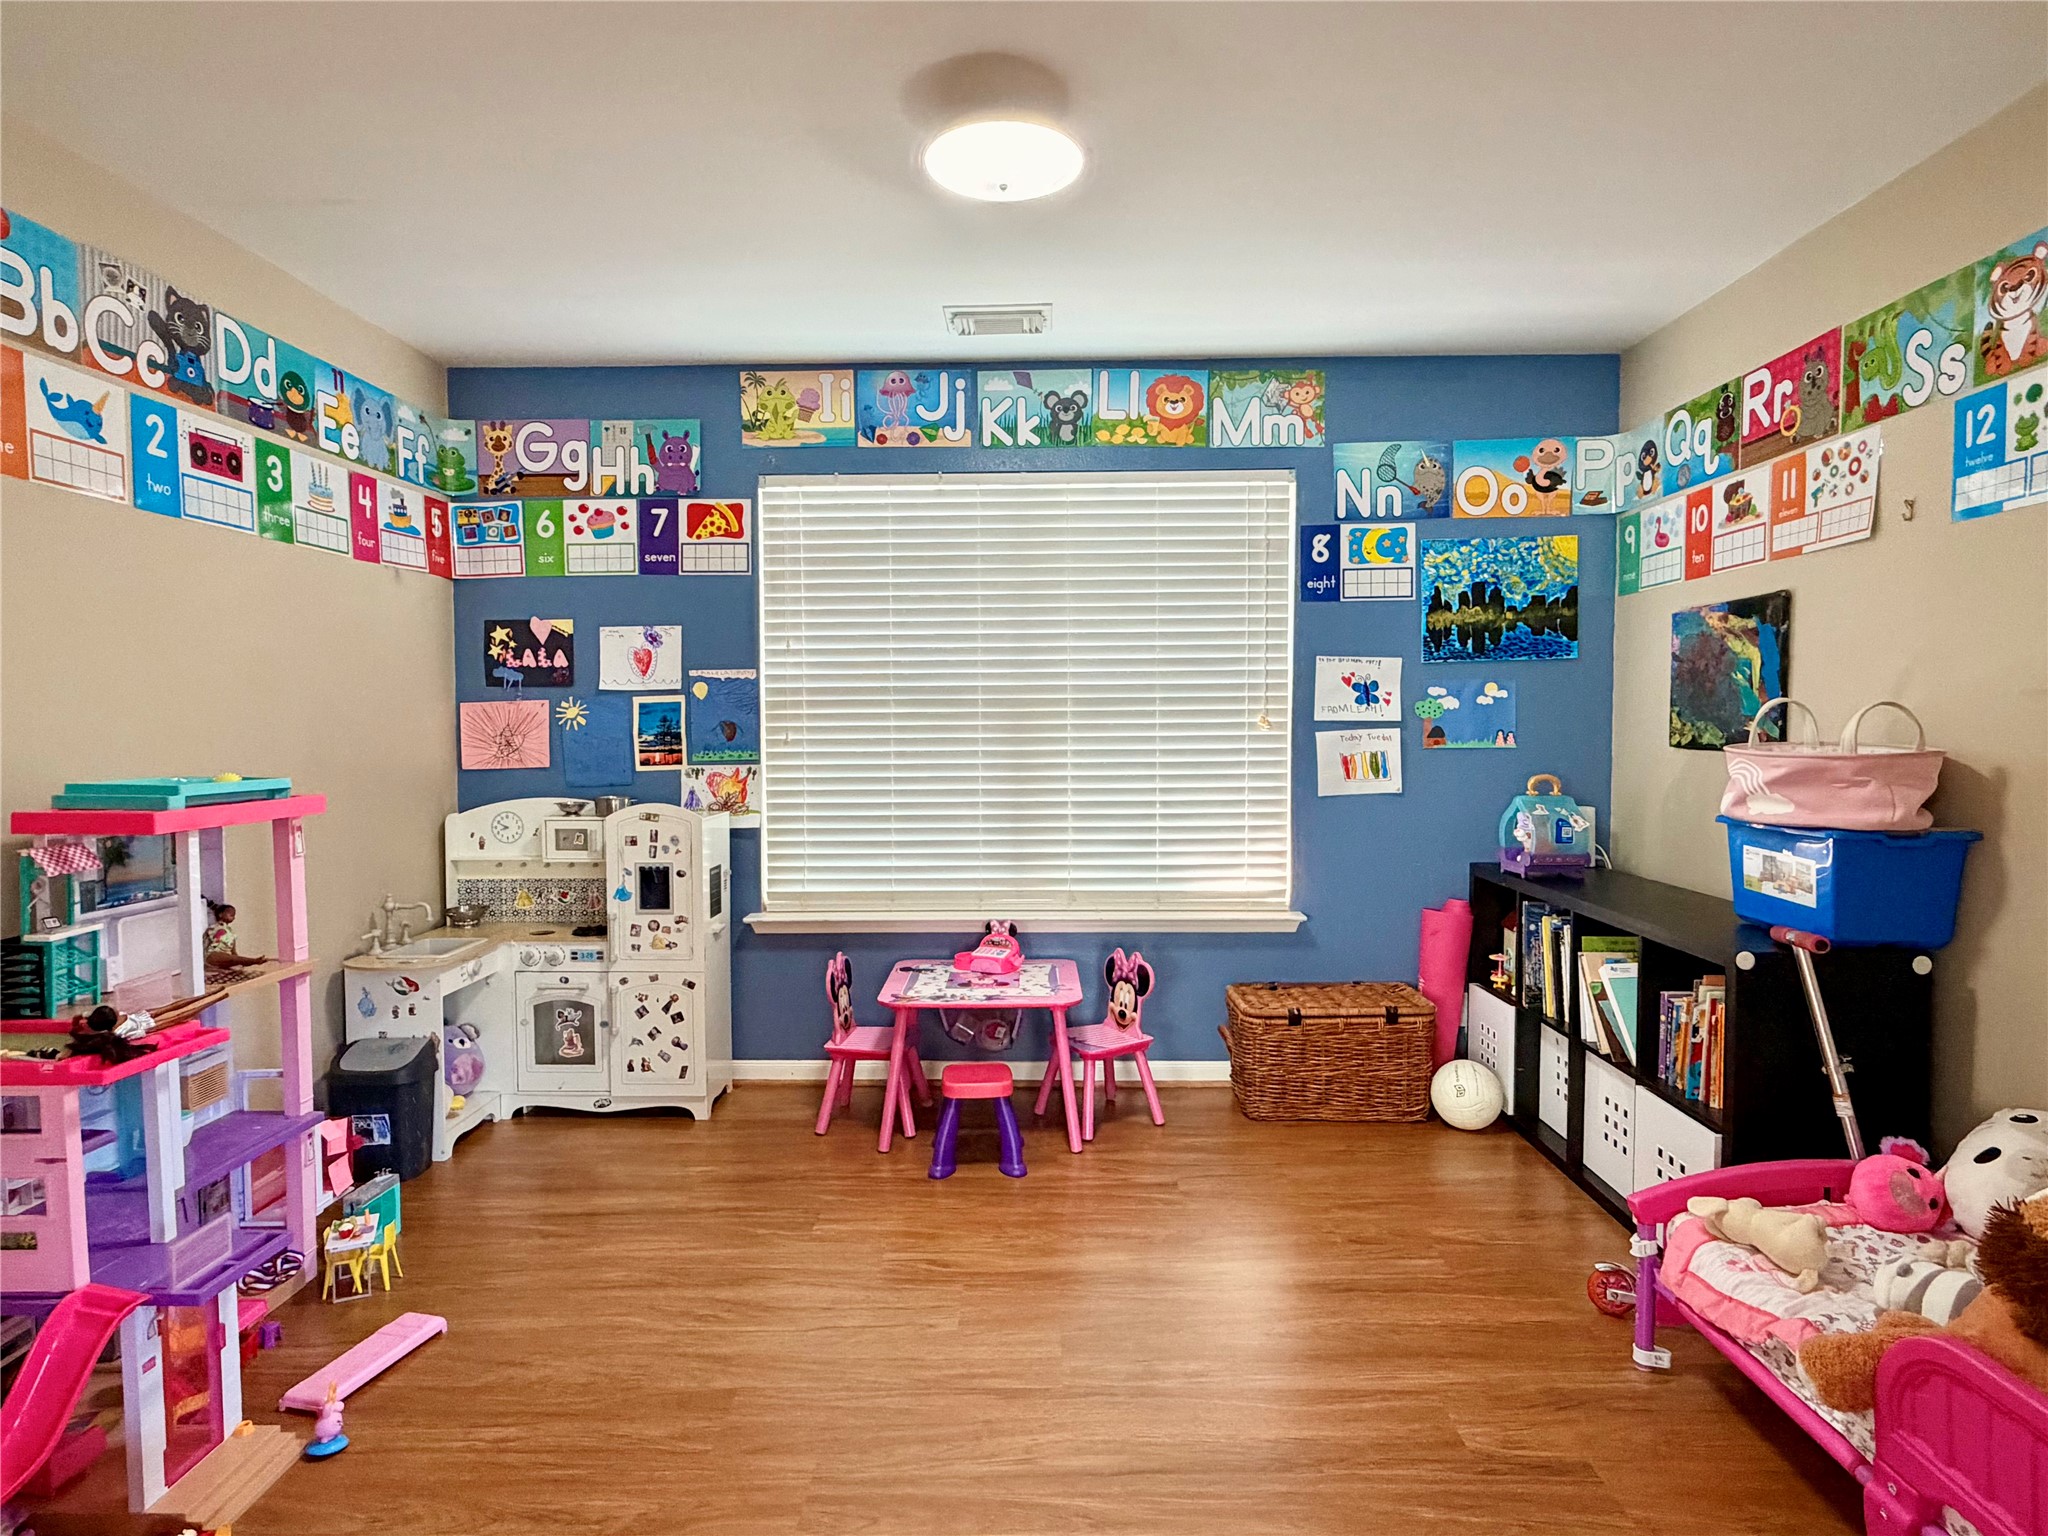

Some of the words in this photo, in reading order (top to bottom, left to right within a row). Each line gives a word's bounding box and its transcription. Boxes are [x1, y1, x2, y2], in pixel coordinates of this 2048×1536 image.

[84, 295, 167, 388] Cc
[215, 312, 277, 400] Dd
[1902, 328, 1966, 408] Ss
[819, 373, 850, 422] Ii
[916, 371, 966, 441] Jj
[1098, 370, 1140, 420] Ll
[1742, 367, 1793, 437] Rr
[145, 415, 168, 458] 2
[316, 390, 360, 460] Ee
[982, 397, 1041, 447] Kk
[1212, 396, 1304, 446] Mm
[1965, 403, 1996, 448] 12
[397, 425, 429, 484] Ff
[515, 421, 588, 492] Gg
[1665, 409, 1719, 475] Qq
[1965, 451, 1994, 468] twelve
[147, 474, 172, 496] two
[267, 455, 283, 492] 3
[592, 446, 655, 495] Hh
[1456, 466, 1528, 515] Oo
[1575, 439, 1636, 507] Pp
[1782, 467, 1797, 501] 11
[358, 484, 372, 518] 4
[1336, 468, 1403, 519] Nn
[261, 507, 290, 527] three
[431, 507, 442, 538] 5
[536, 509, 555, 538] 6
[650, 508, 669, 537] 7
[1691, 504, 1708, 534] 10
[357, 533, 375, 549] four
[431, 549, 445, 565] five
[538, 552, 554, 564] six
[644, 553, 676, 563] seven
[1311, 533, 1331, 563] 8
[1624, 526, 1635, 554] 9
[1692, 550, 1704, 564] ten
[1306, 575, 1335, 593] eight
[506, 647, 569, 668] LALA
